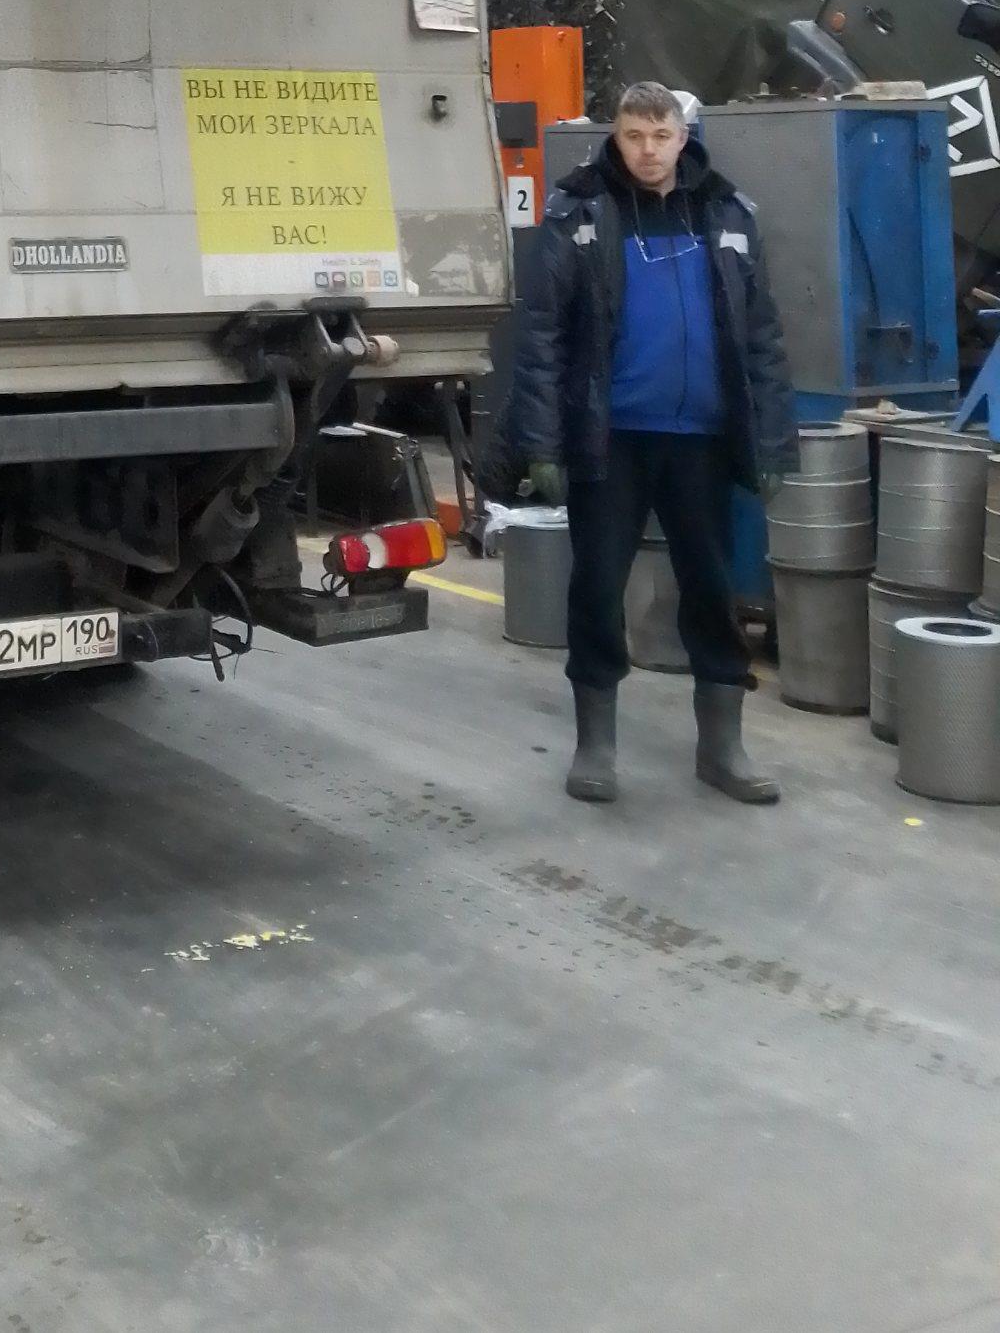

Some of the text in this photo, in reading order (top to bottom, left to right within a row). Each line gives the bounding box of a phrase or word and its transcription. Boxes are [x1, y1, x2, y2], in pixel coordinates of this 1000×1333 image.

[186, 79, 379, 103] ВЫ НЕ ВИДИТЕ
[197, 114, 377, 136] МОИ ЗЕРКАЛА
[221, 186, 369, 207] Я НЕ ВИЖУ
[517, 189, 529, 211] 2
[272, 224, 327, 245] ВАС!
[12, 244, 127, 266] DHOLLANDIA
[66, 616, 110, 646] 190
[75, 645, 98, 656] RUS
